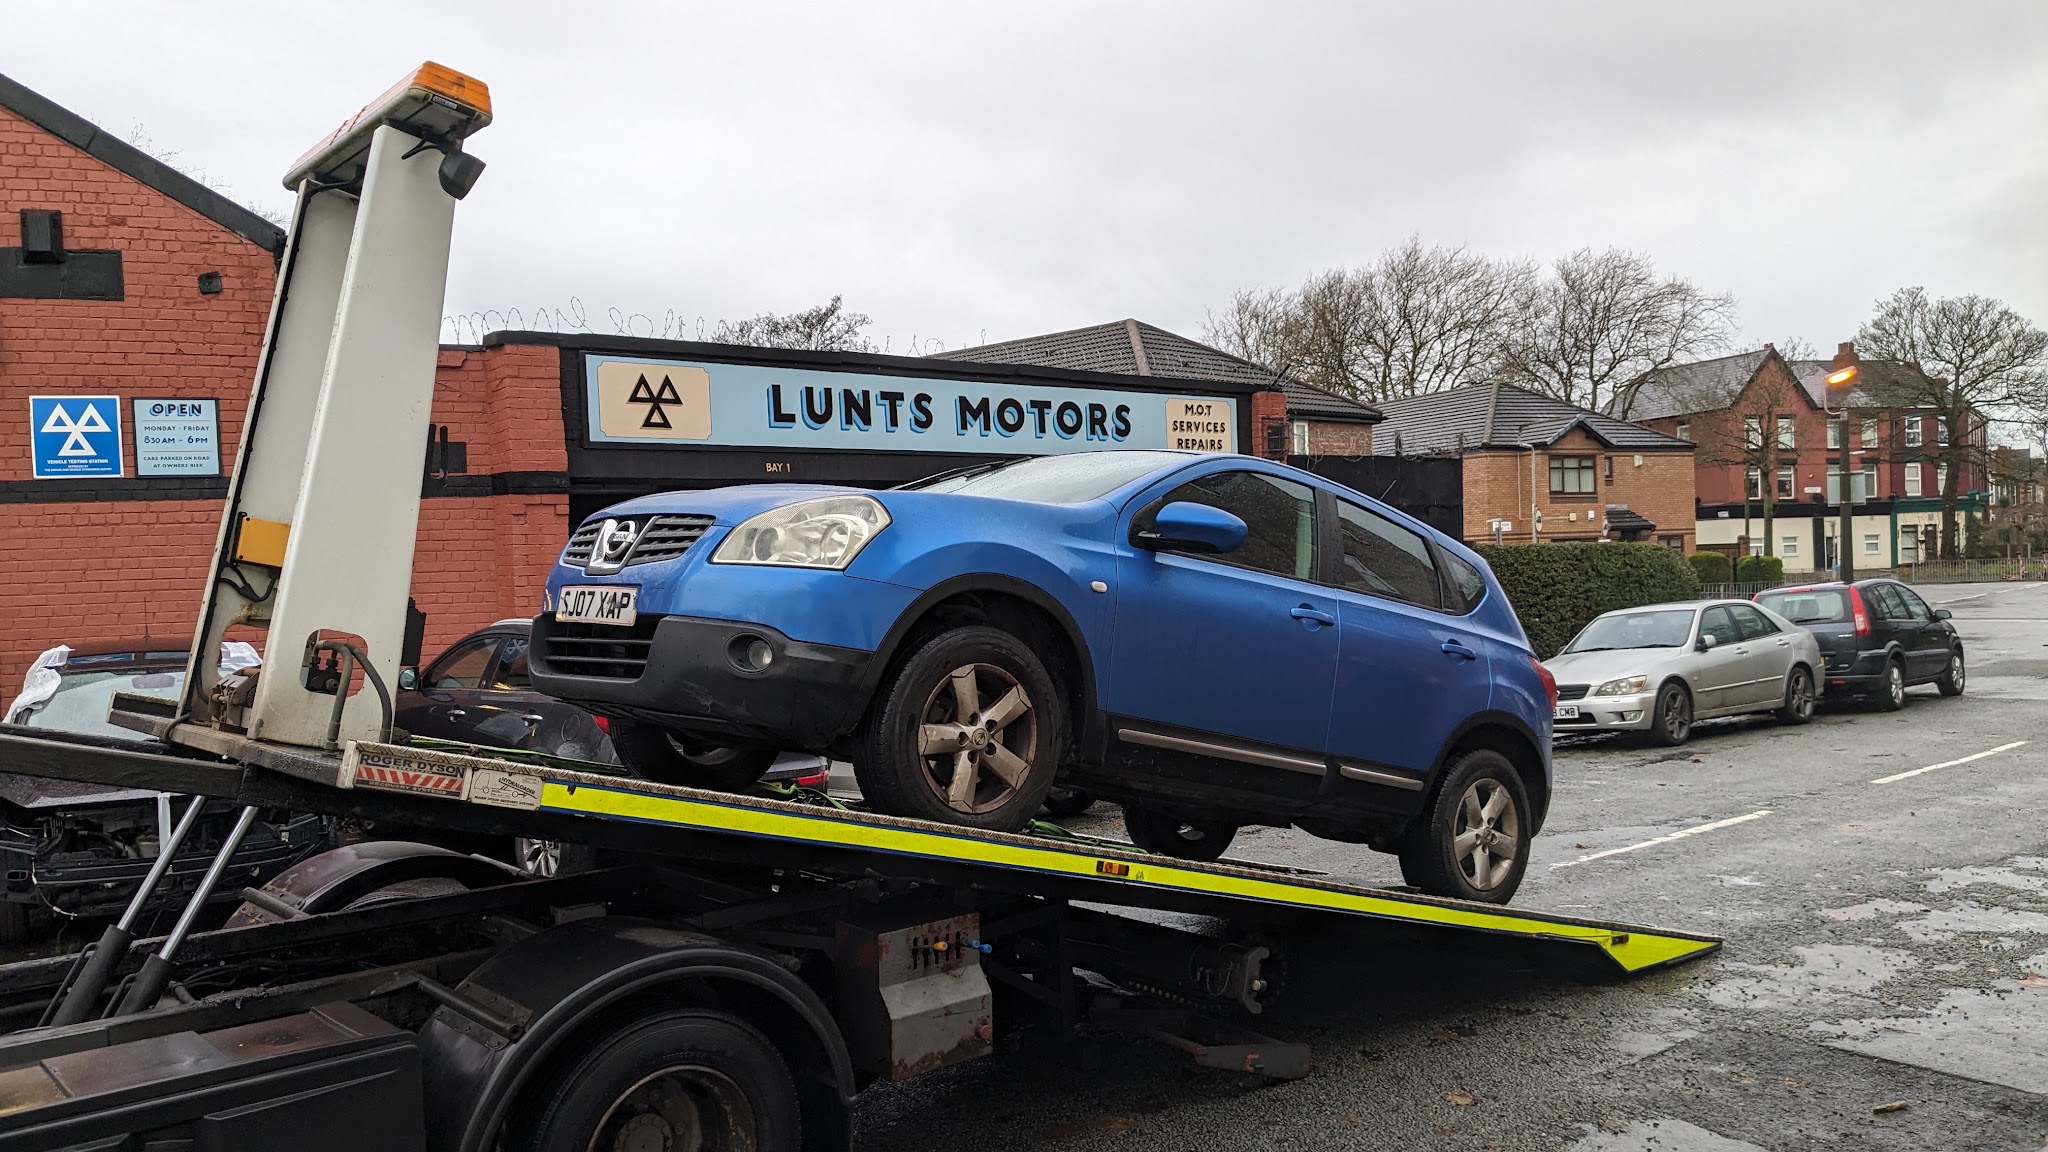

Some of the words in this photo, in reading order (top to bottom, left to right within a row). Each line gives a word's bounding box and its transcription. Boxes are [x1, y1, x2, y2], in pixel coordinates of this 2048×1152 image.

[149, 403, 202, 416] OPEN
[767, 384, 933, 434] LUNTS
[955, 395, 1131, 442] MOTORS
[1185, 404, 1212, 416] M.O.T
[1172, 420, 1226, 434] SERVICES
[1177, 438, 1223, 451] REPAIRS
[766, 462, 783, 472] BAY
[786, 463, 791, 472] 1
[562, 590, 595, 617] SJ07
[1559, 707, 1575, 717] CMB
[360, 753, 412, 768] ROGER
[417, 761, 465, 778] DYSON
[369, 781, 410, 790] RECOVERY
[411, 786, 447, 795] SYSTEMS
[501, 776, 536, 795] HYDRALOADER
